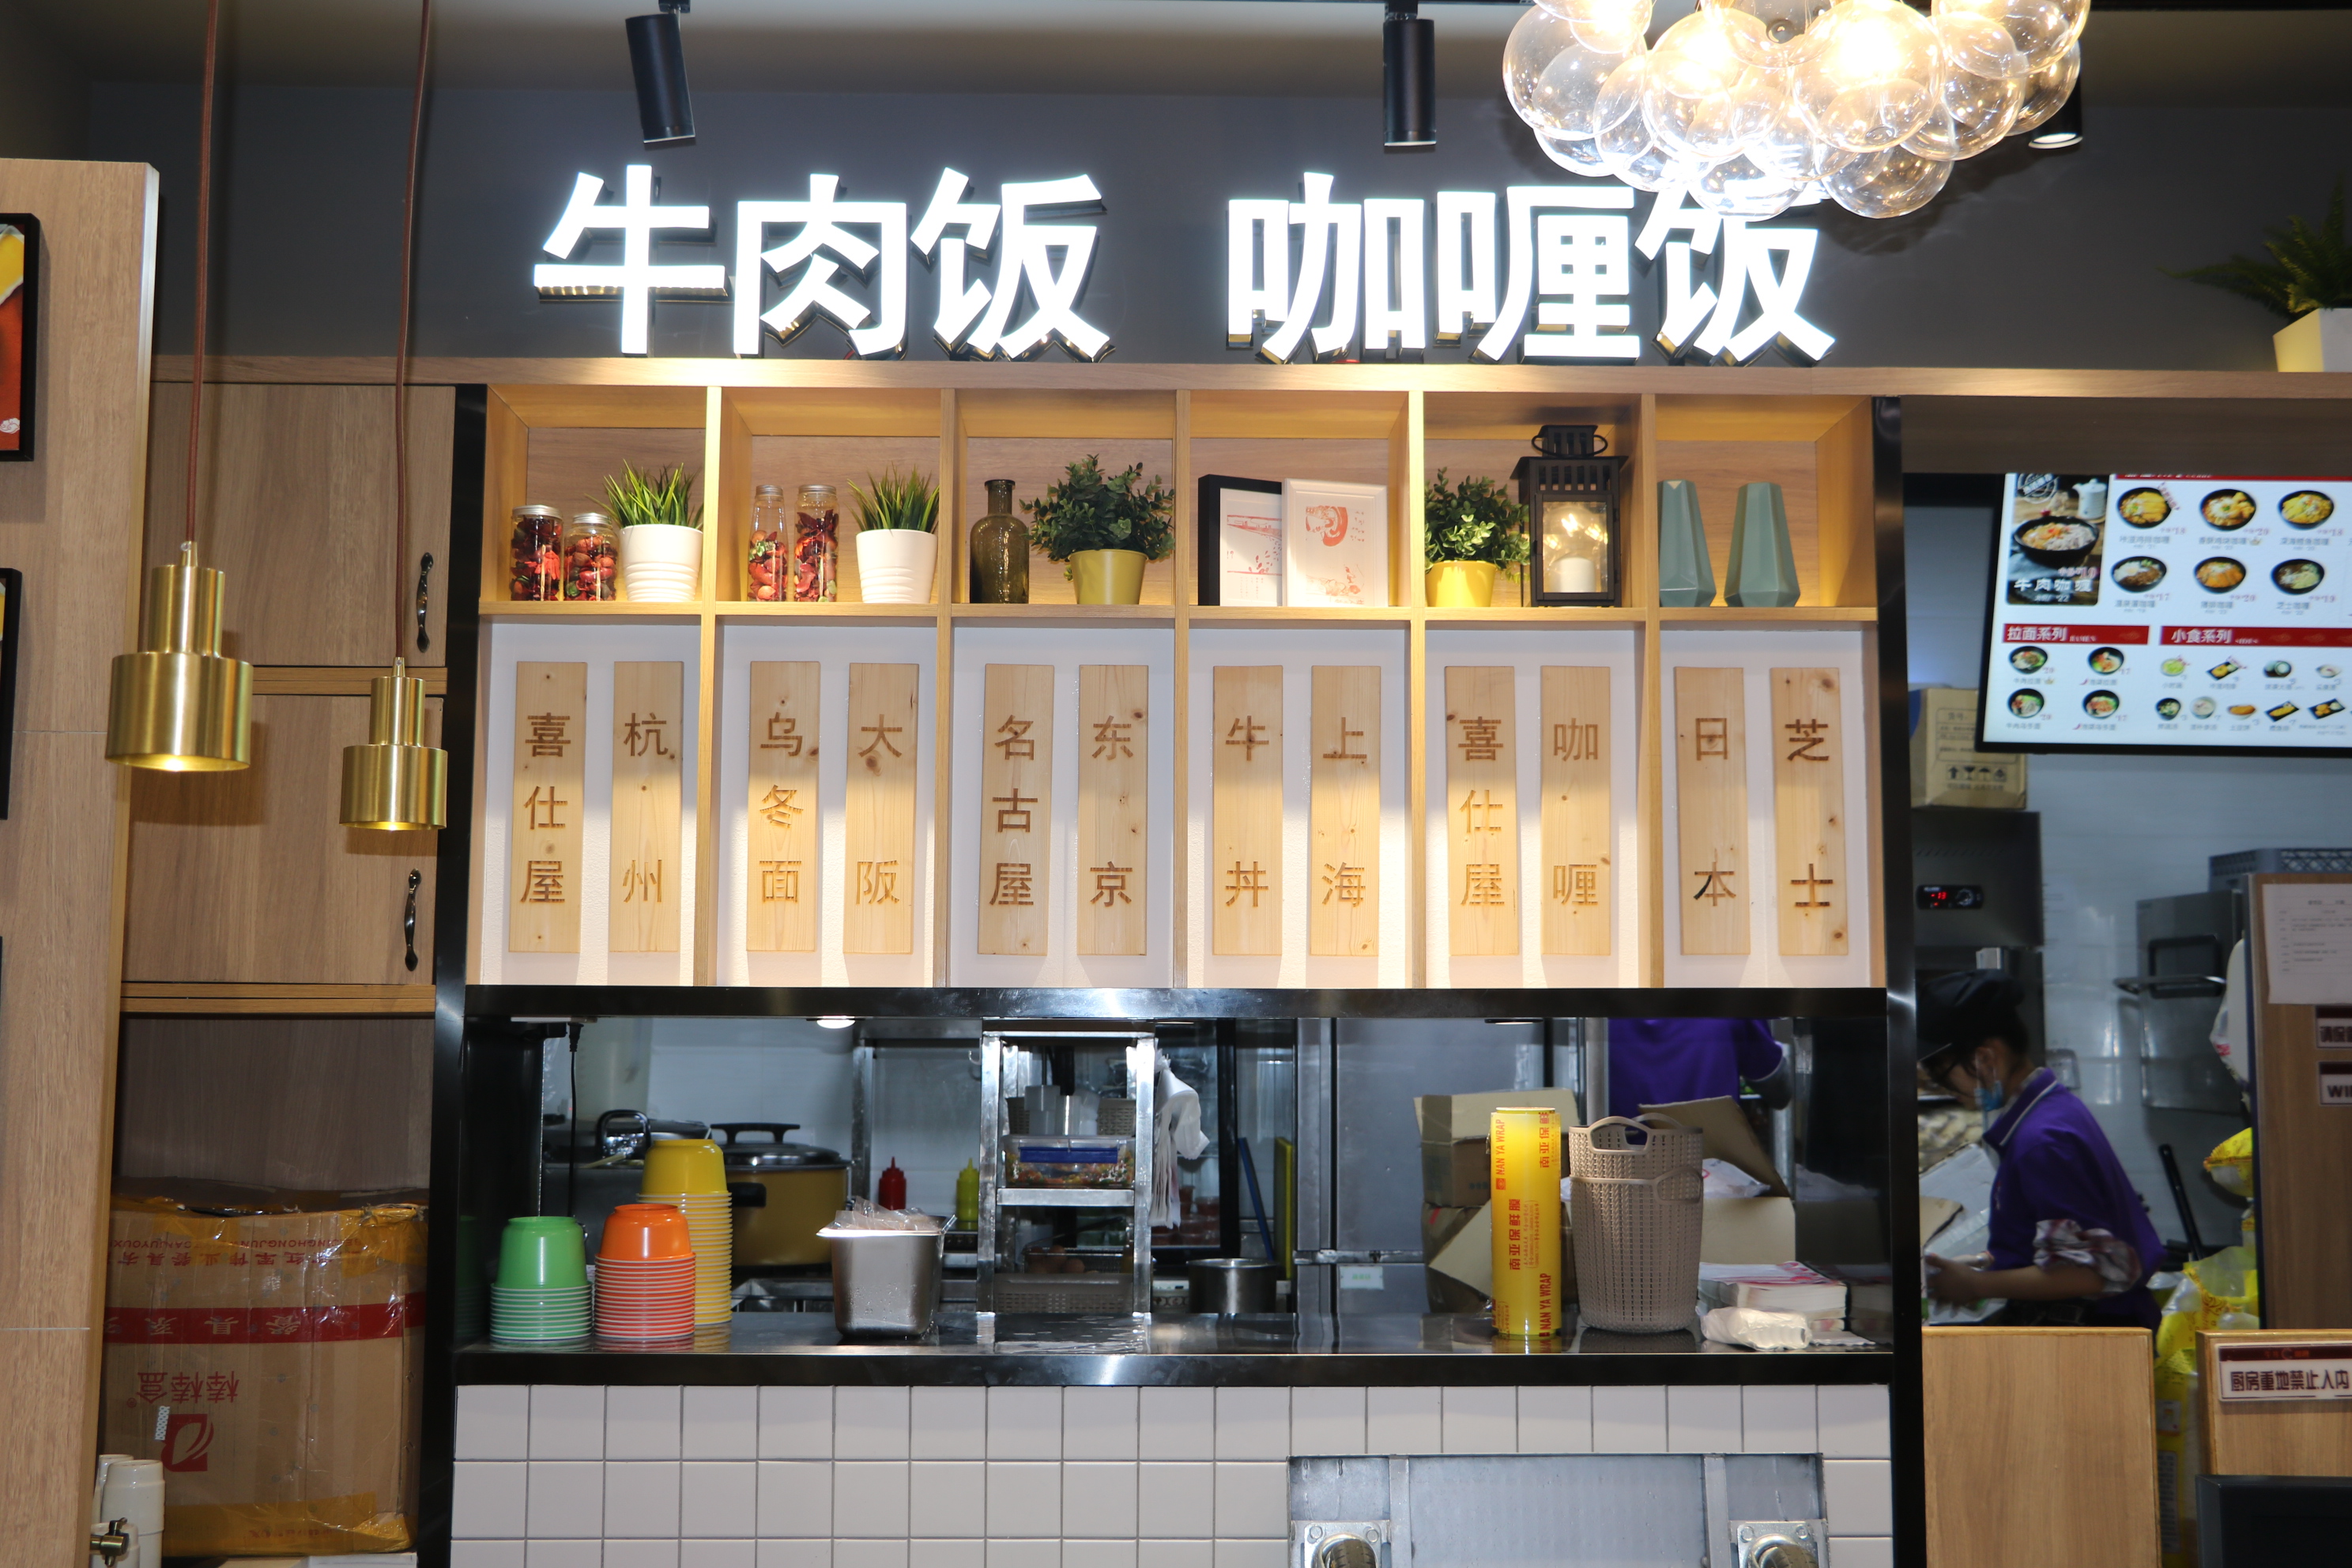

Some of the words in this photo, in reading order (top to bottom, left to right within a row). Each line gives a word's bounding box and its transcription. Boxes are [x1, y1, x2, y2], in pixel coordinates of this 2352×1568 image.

[533, 164, 1111, 360] 牛肉饭
[1227, 172, 1837, 362] 咖喱饭
[2007, 626, 2067, 642] 拉面系列
[2171, 628, 2233, 643] 小食系列
[519, 712, 571, 904] 喜仕屋
[622, 712, 669, 903] 杭州
[759, 711, 805, 904] 乌冬面
[855, 714, 903, 906] 大阪
[989, 714, 1038, 906] 名古屋
[1089, 715, 1134, 907] 东京
[1321, 717, 1368, 907] 上海
[1458, 716, 1506, 906] 喜仕屋
[1552, 717, 1600, 906] 咖喱
[1693, 717, 1737, 906] 日本
[1784, 718, 1834, 908] 芝士
[1495, 1118, 1506, 1143] WRAP
[1495, 1144, 1506, 1155] YA
[1495, 1158, 1506, 1175] NAN
[1509, 1198, 1521, 1271] 南亚保鲜膜
[1539, 1272, 1551, 1296] WRAP
[1539, 1298, 1551, 1310] YA
[1539, 1311, 1551, 1329] NAN
[137, 1370, 240, 1405] 棒棒盒
[2230, 1370, 2350, 1392] 厨房重地禁止入内
